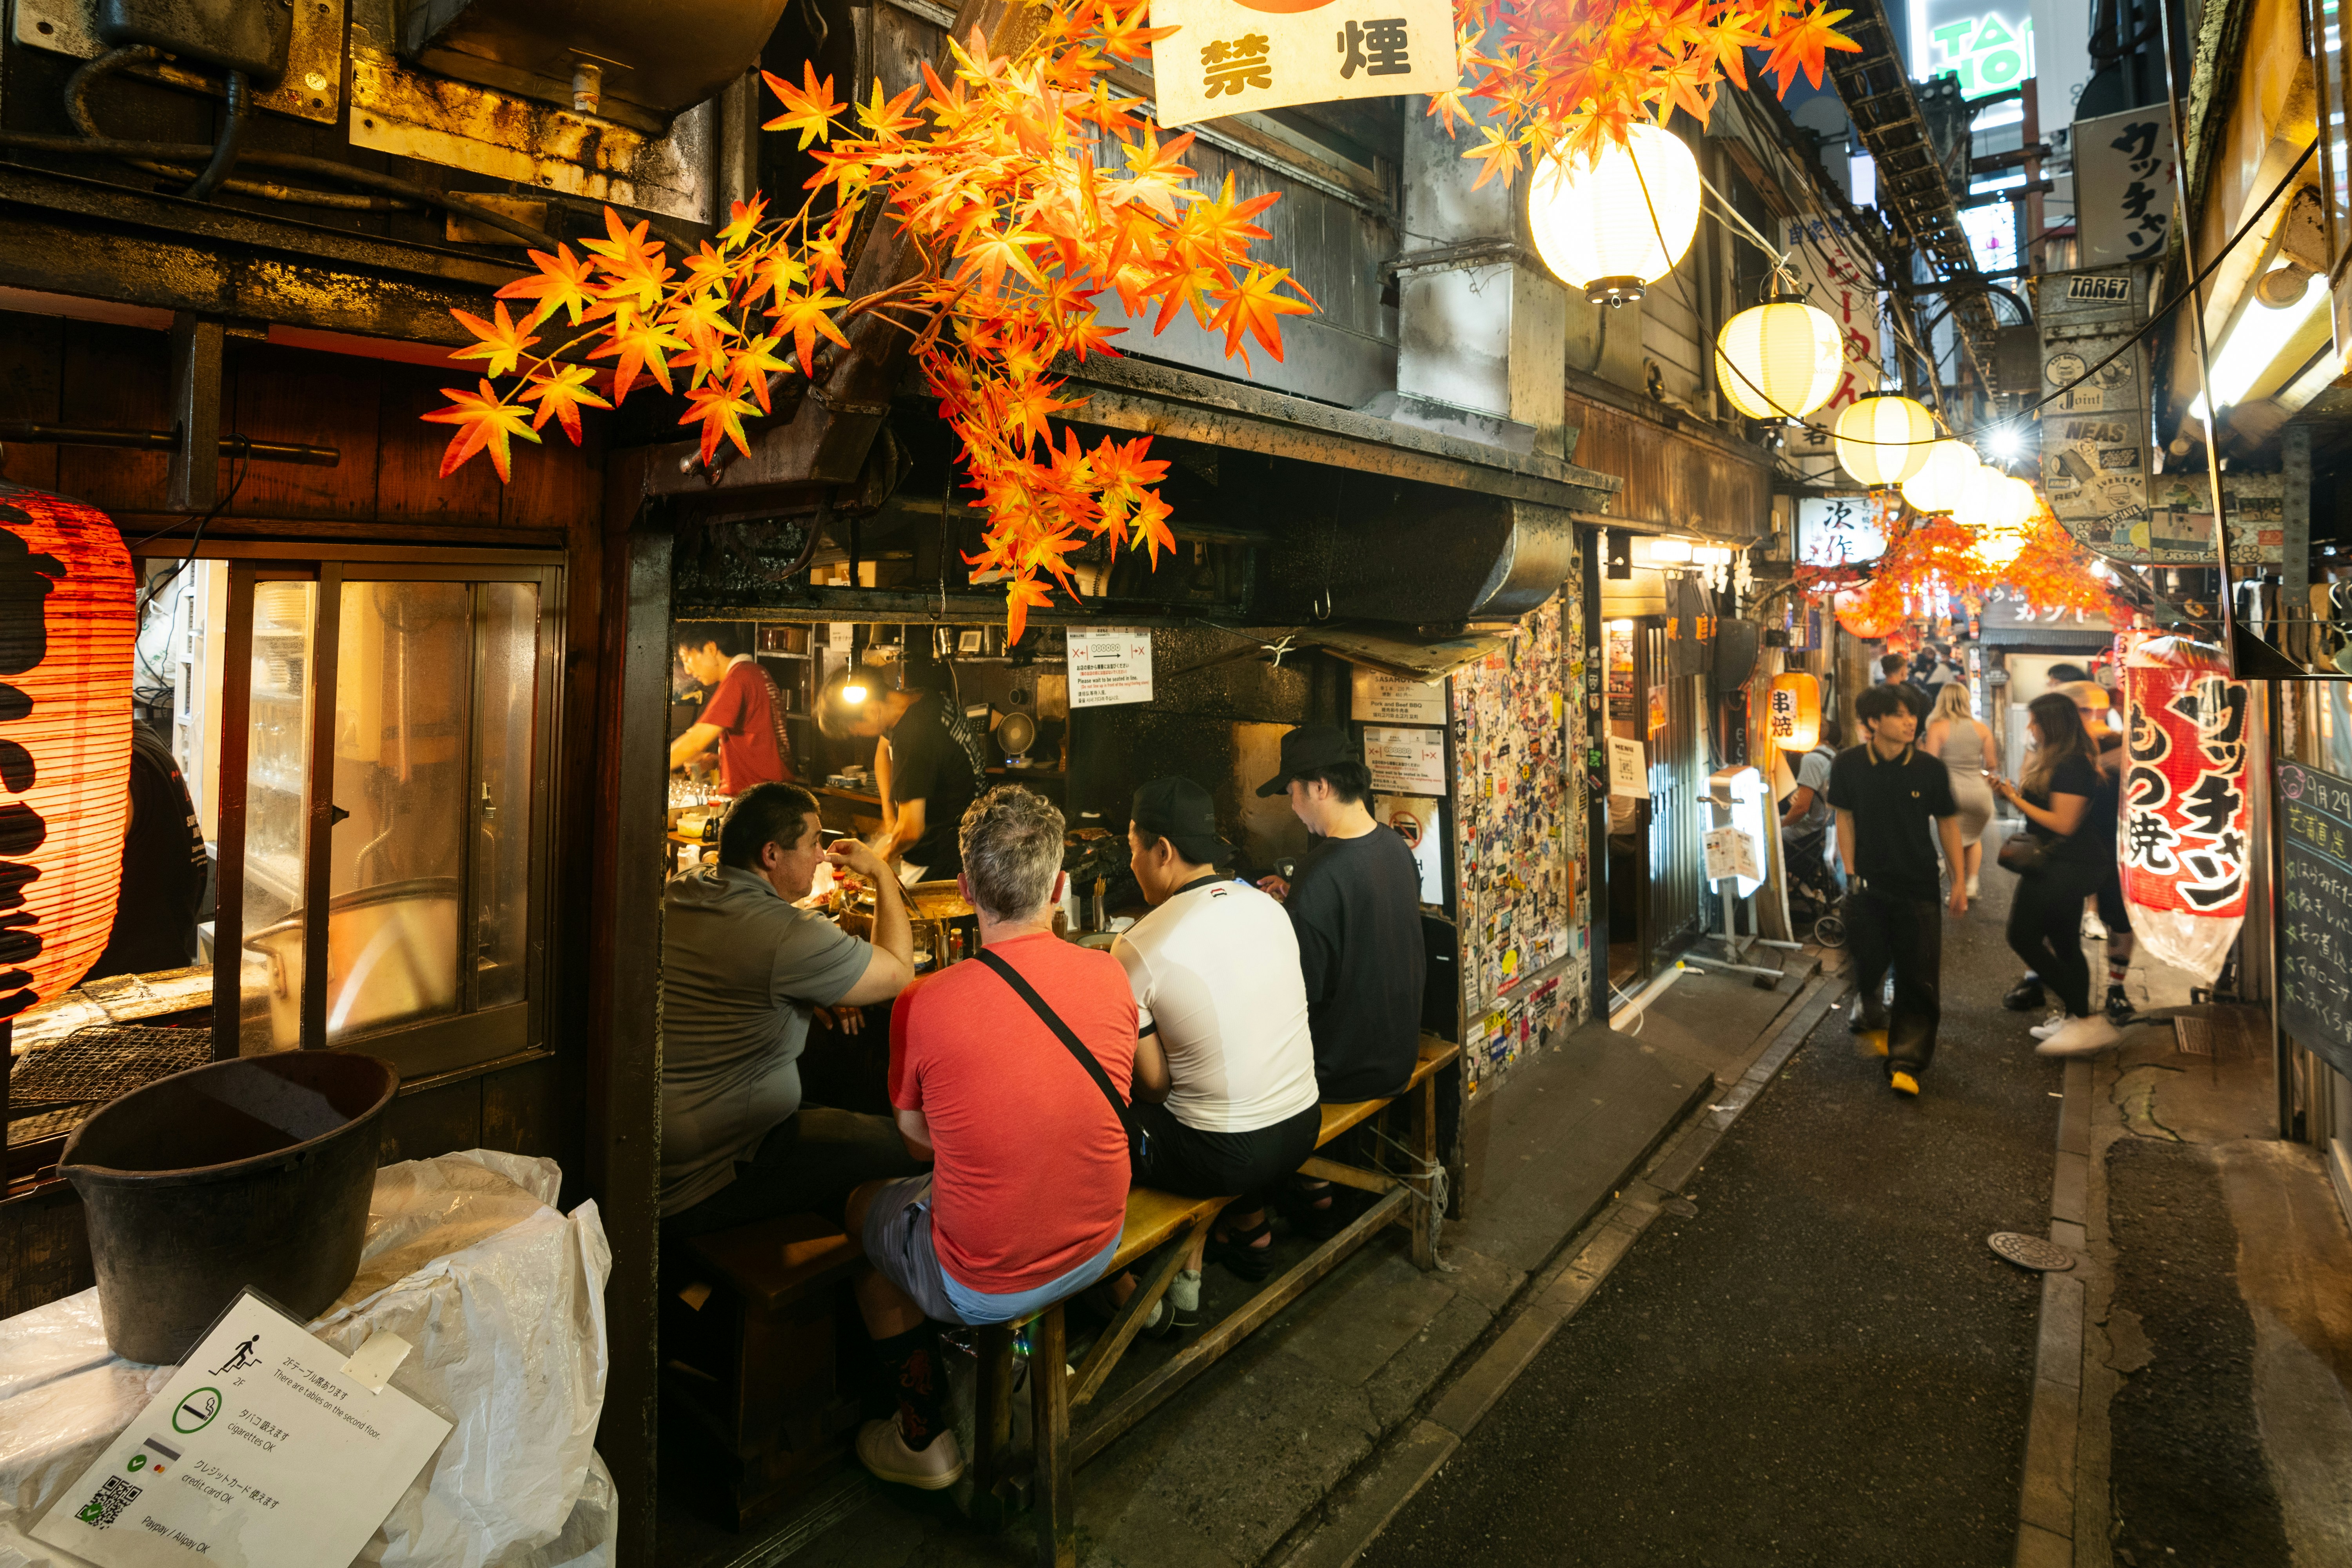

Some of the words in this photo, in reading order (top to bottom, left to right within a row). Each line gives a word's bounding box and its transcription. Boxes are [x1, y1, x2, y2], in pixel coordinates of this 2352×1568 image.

[1773, 691, 1792, 737] 串焼
[233, 1377, 246, 1387] 2F
[274, 1368, 293, 1385] There
[292, 1382, 304, 1393] are
[303, 1388, 324, 1405] tables
[323, 1401, 332, 1410] on
[332, 1405, 344, 1417] the
[343, 1414, 366, 1430] second
[365, 1425, 380, 1440] floor.
[228, 1423, 263, 1446] cigarettes
[263, 1441, 276, 1453] OK
[182, 1474, 205, 1490] credit
[204, 1485, 221, 1498] card
[220, 1493, 234, 1504] OK
[142, 1516, 169, 1536] Paypay
[172, 1531, 197, 1549] Alipay
[196, 1542, 211, 1554] OK
